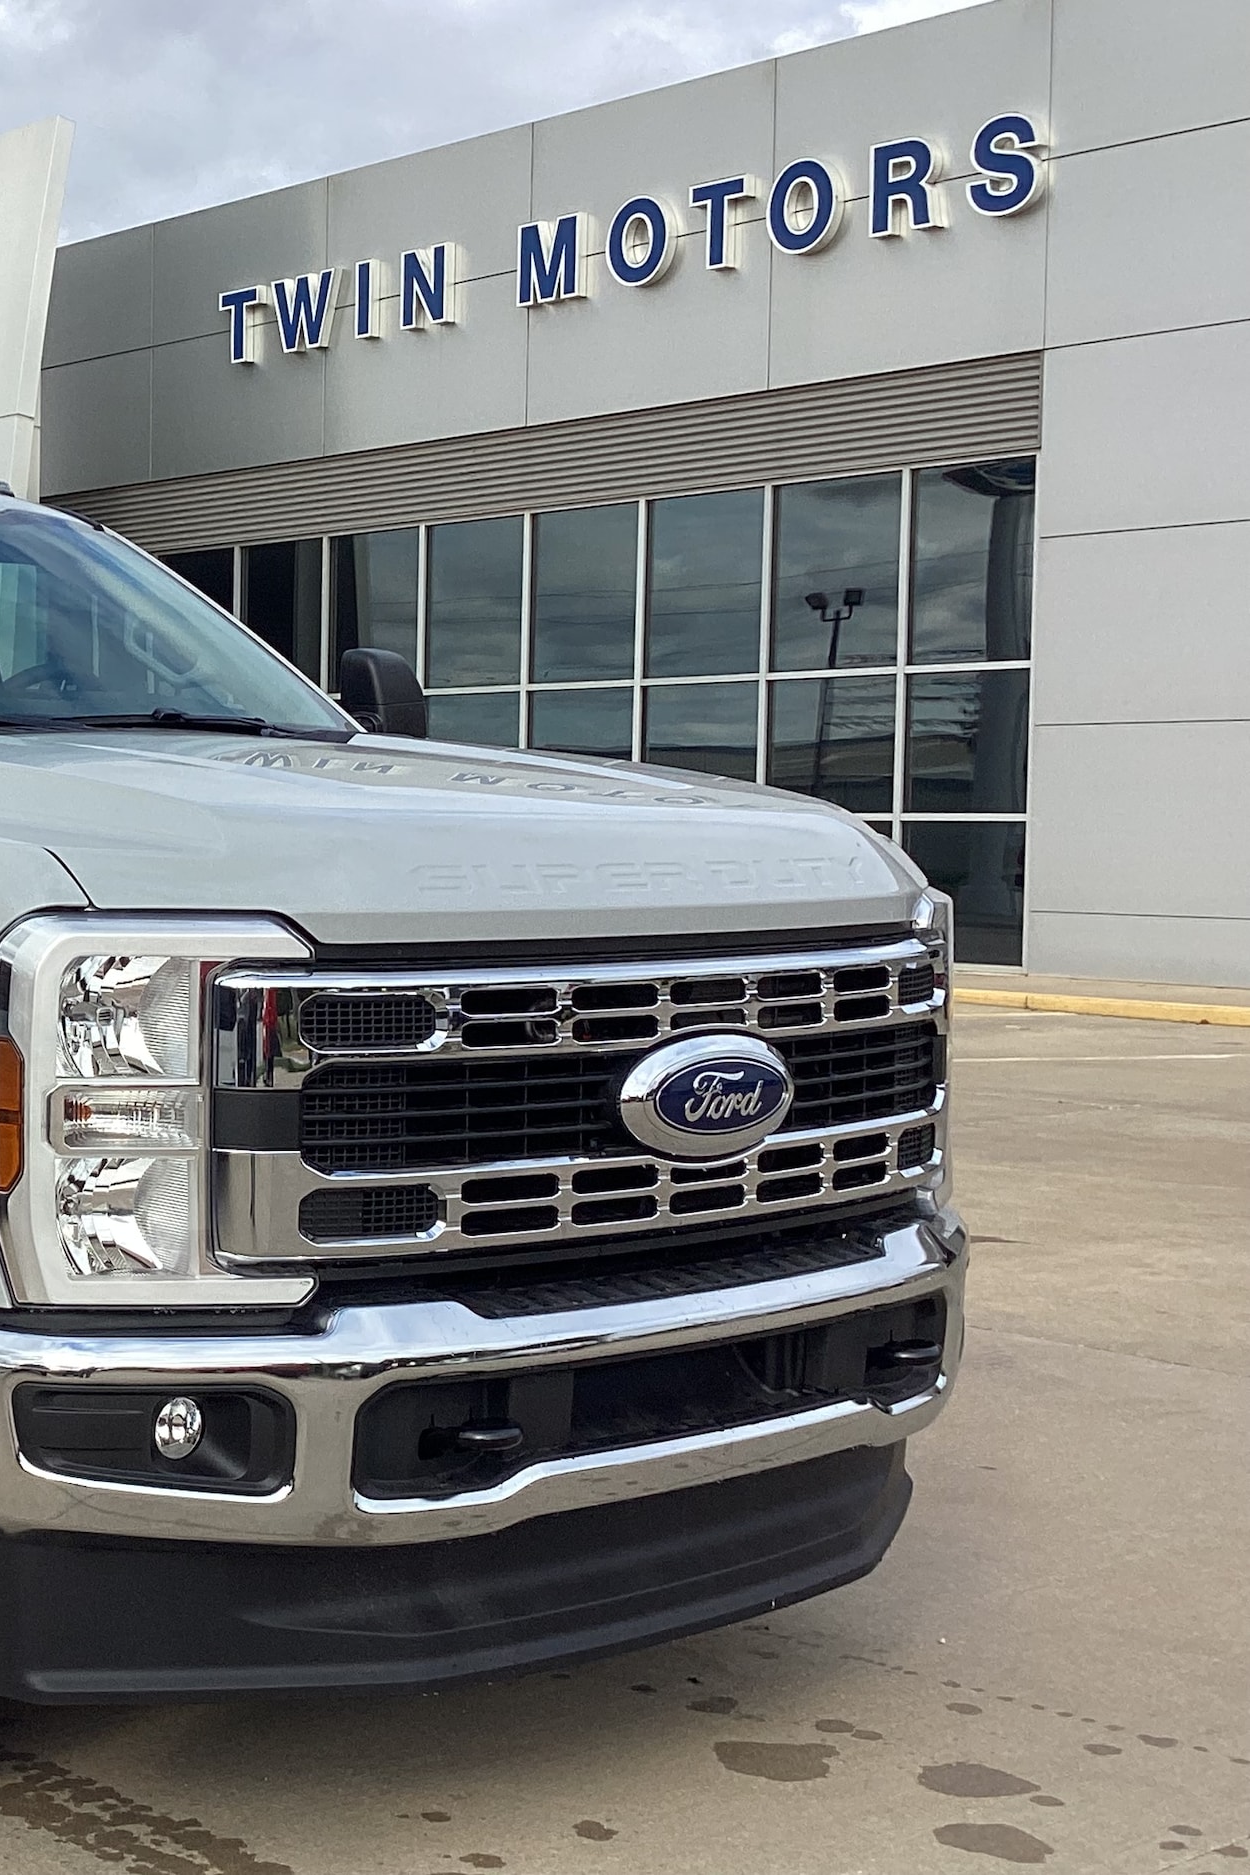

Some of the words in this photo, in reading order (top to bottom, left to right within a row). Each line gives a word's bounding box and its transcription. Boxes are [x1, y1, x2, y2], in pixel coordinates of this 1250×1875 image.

[219, 242, 455, 364] TWIN
[516, 112, 1048, 307] MOTORS
[407, 861, 702, 895] SUPER
[703, 856, 865, 889] DUTY
[684, 1071, 764, 1122] Ford
